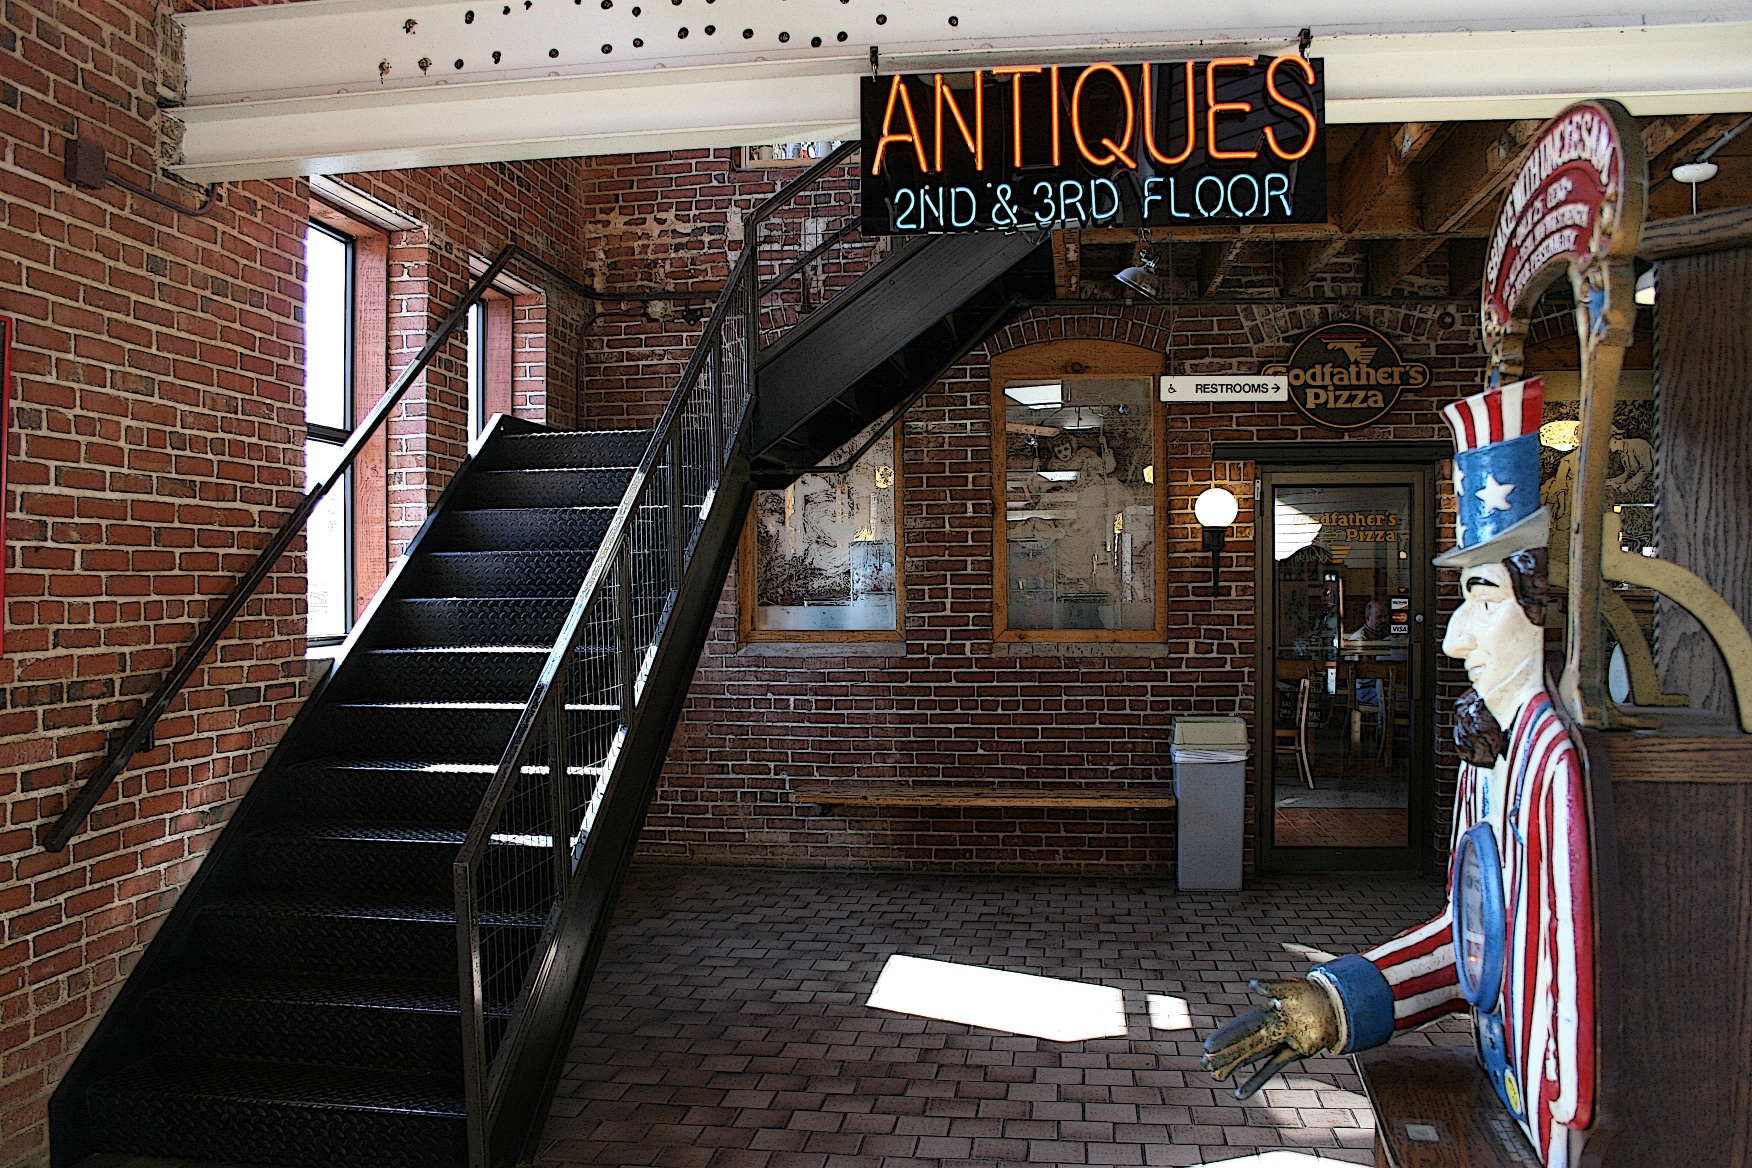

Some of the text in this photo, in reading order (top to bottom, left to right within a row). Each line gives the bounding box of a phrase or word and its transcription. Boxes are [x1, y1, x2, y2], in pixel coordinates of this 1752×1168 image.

[871, 54, 1317, 176] ANTIQUES
[893, 173, 1293, 230] 2ND & 3RD FLOOR
[1195, 383, 1269, 394] RESTROOMS
[1305, 387, 1385, 409] Pizza
[1293, 511, 1398, 527] dfather's
[1345, 527, 1397, 542] Pizza
